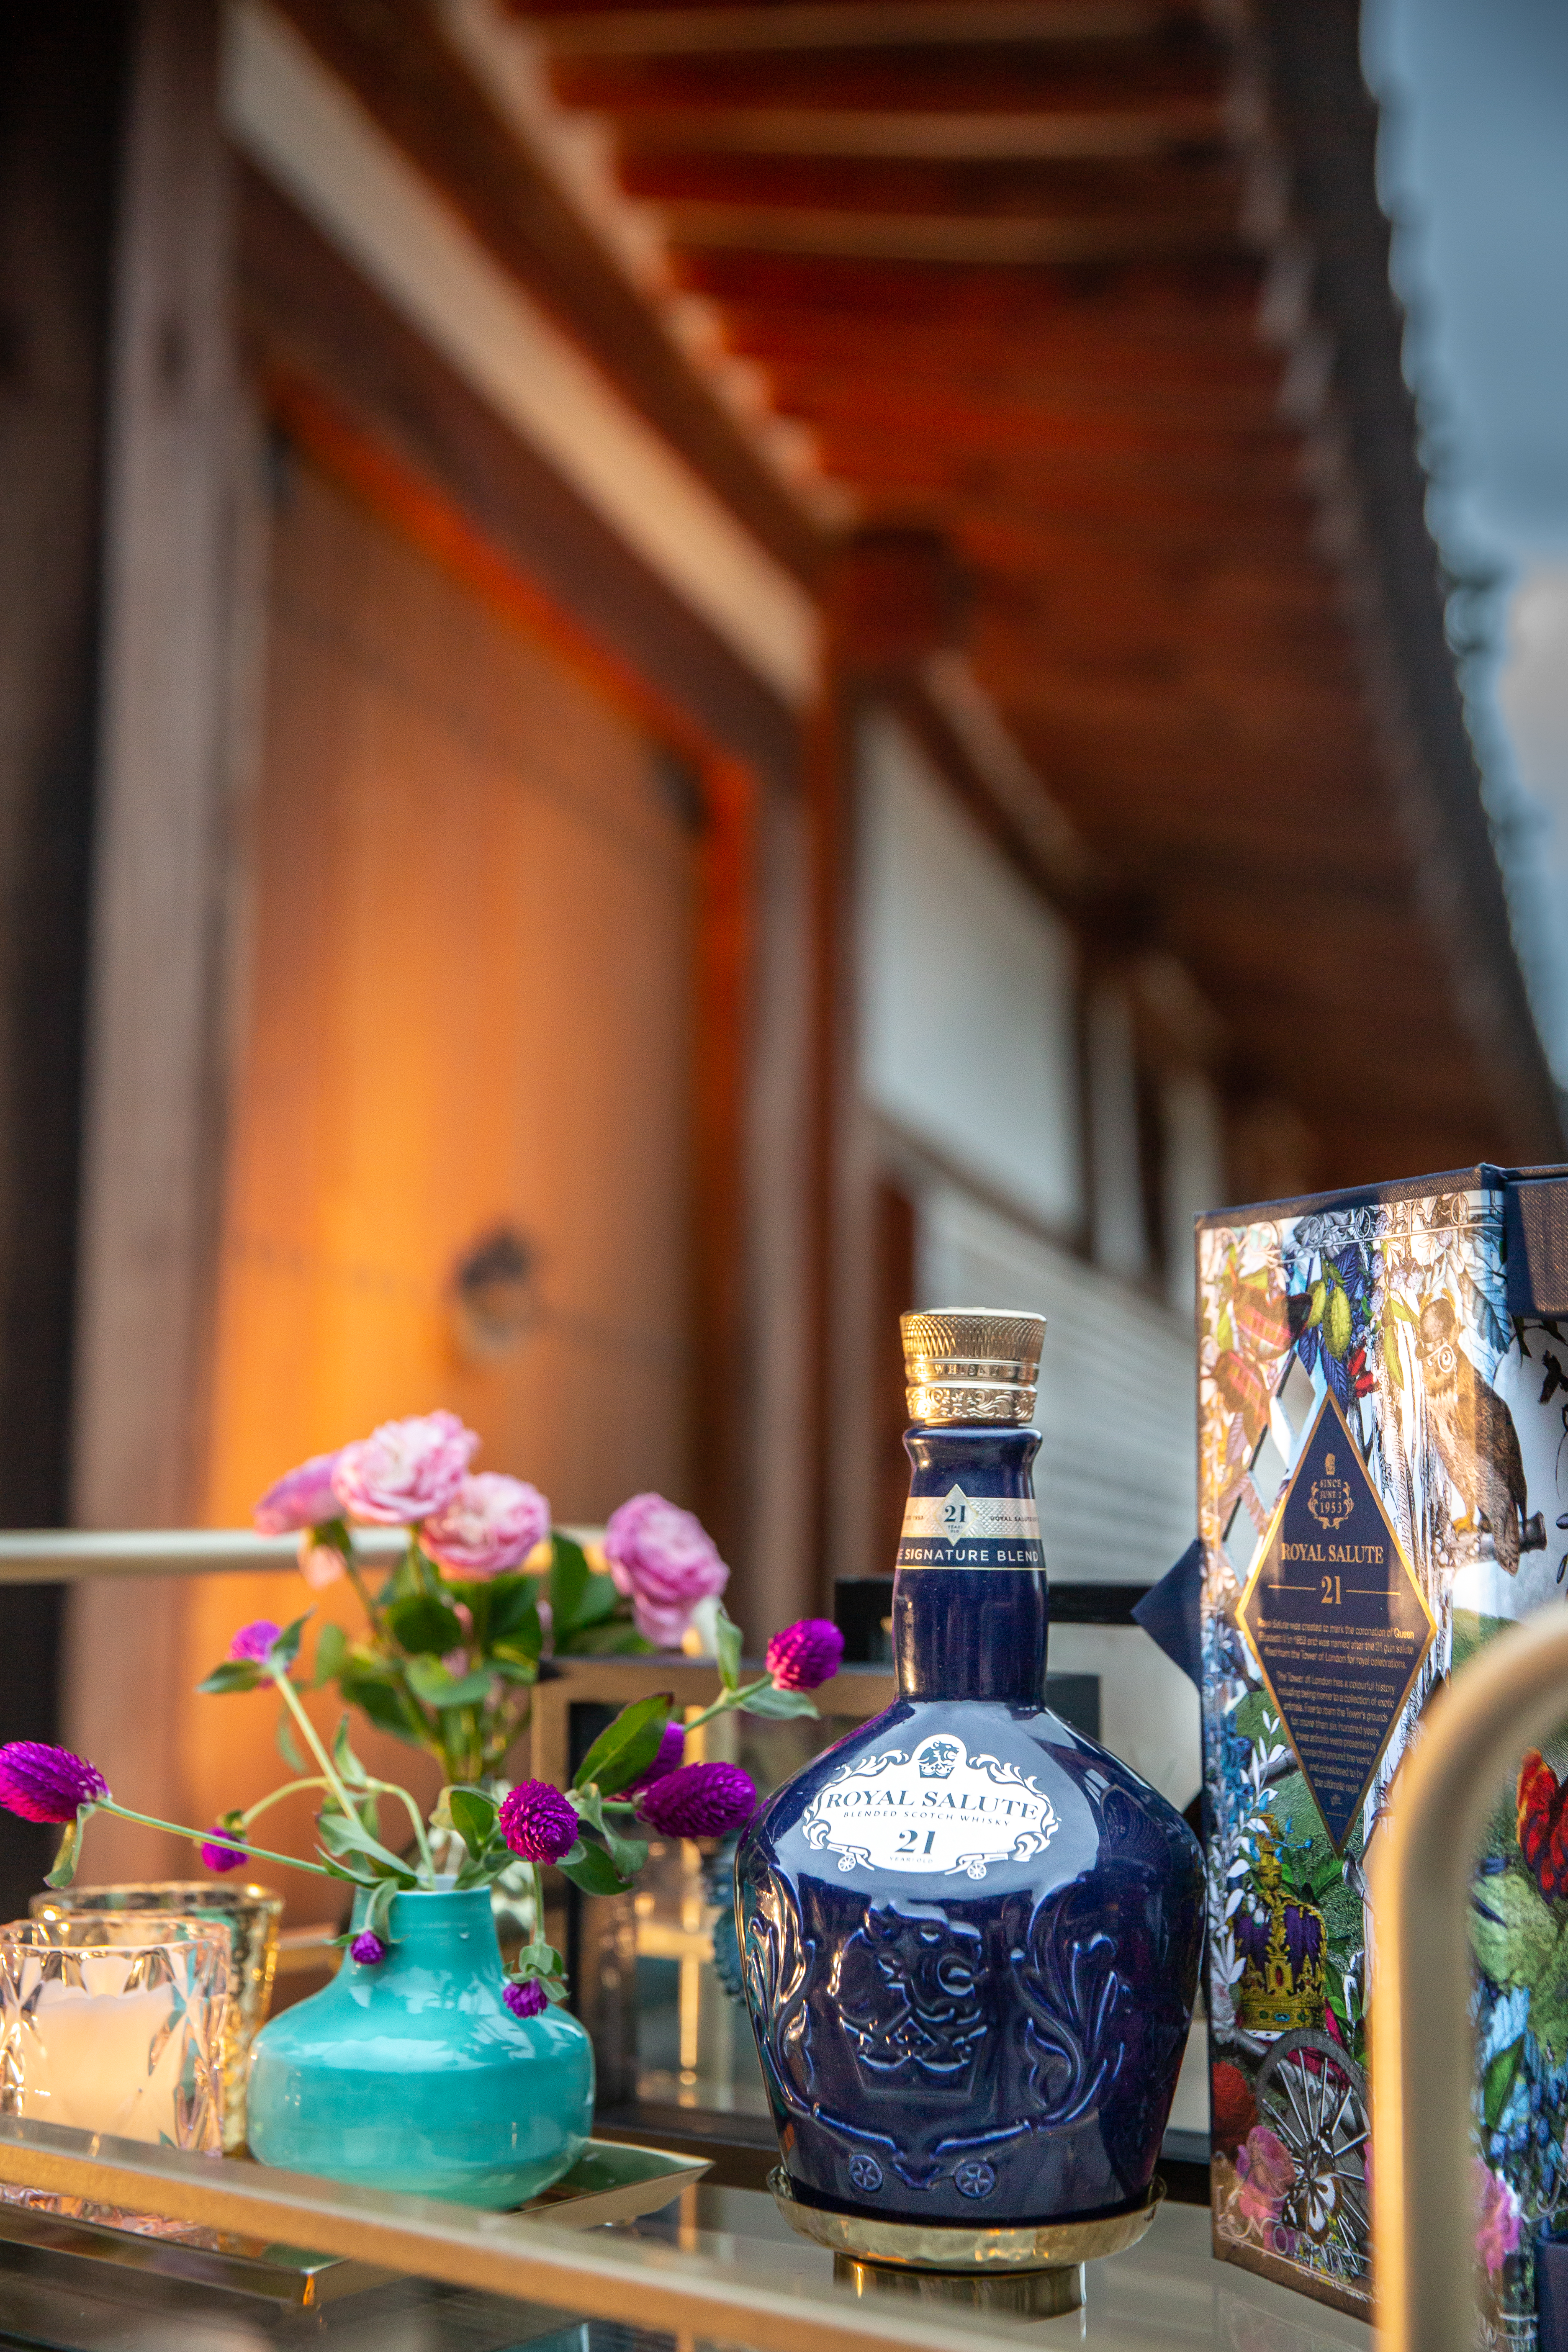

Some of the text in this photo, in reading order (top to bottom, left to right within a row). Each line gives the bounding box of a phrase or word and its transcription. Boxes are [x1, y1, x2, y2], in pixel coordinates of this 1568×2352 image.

[1320, 1479, 1341, 1488] SINCE
[1320, 1490, 1336, 1499] JUNE
[944, 1505, 966, 1522] 21
[1320, 1502, 1342, 1514] 1953
[905, 1548, 989, 1561] SIGNATURE
[997, 1550, 1038, 1562] BLEND
[1281, 1543, 1383, 1564] ROYAL SALUTE
[1321, 1576, 1342, 1604] 21
[1345, 1625, 1355, 1635] the
[1356, 1626, 1386, 1637] coronation
[1387, 1627, 1393, 1638] of
[1394, 1628, 1414, 1640] Queen
[1365, 1641, 1375, 1651] the
[1384, 1644, 1395, 1655] gun
[1396, 1643, 1414, 1655] salute
[1318, 1651, 1324, 1661] of
[1325, 1652, 1346, 1663] London
[1356, 1655, 1370, 1668] royal
[1311, 1674, 1332, 1686] London
[1349, 1680, 1375, 1691] colourful
[1375, 1681, 1395, 1695] history
[1344, 1694, 1370, 1705] collection
[1371, 1696, 1377, 1706] of
[1378, 1698, 1394, 1708] exotic
[825, 1789, 1038, 1820] ROYAL SALUTE
[904, 1811, 953, 1820] SCOTCH
[961, 1815, 1010, 1826] WHISKY
[894, 1830, 936, 1855] 21
